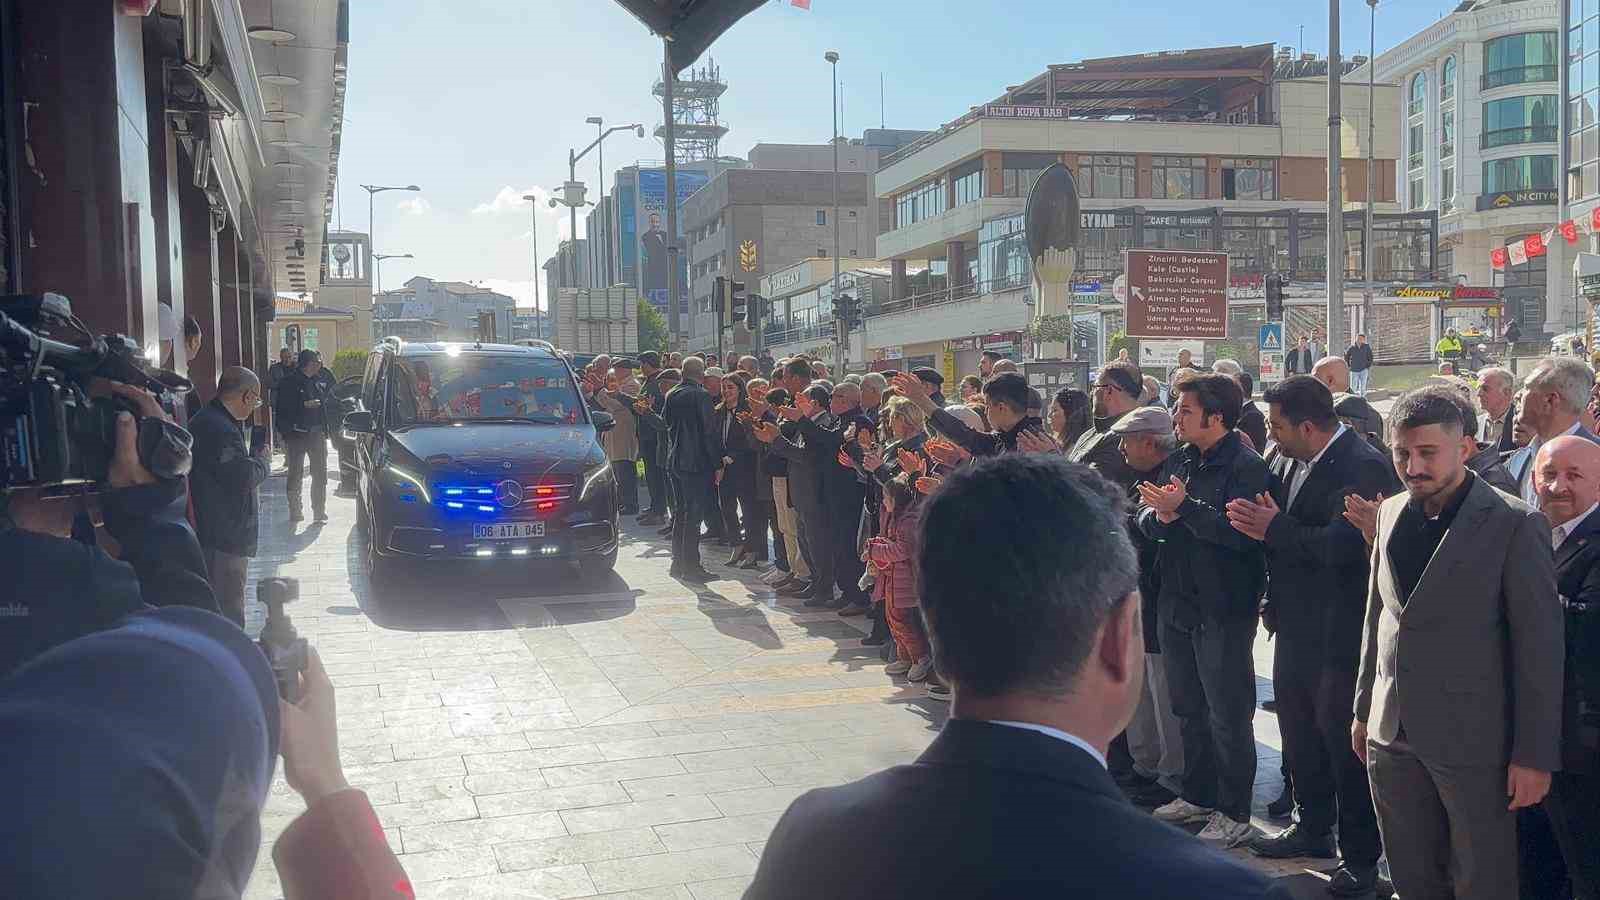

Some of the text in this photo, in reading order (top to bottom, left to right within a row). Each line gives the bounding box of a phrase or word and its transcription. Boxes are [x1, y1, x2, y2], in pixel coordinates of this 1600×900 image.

[1017, 107, 1040, 117] KUPA
[1043, 108, 1063, 117] BAR
[1148, 255, 1218, 264] Zincirli Bedesten
[1148, 265, 1199, 274] Kale (Castle)
[1180, 306, 1211, 314] Kahvesi
[500, 526, 519, 537] ATA
